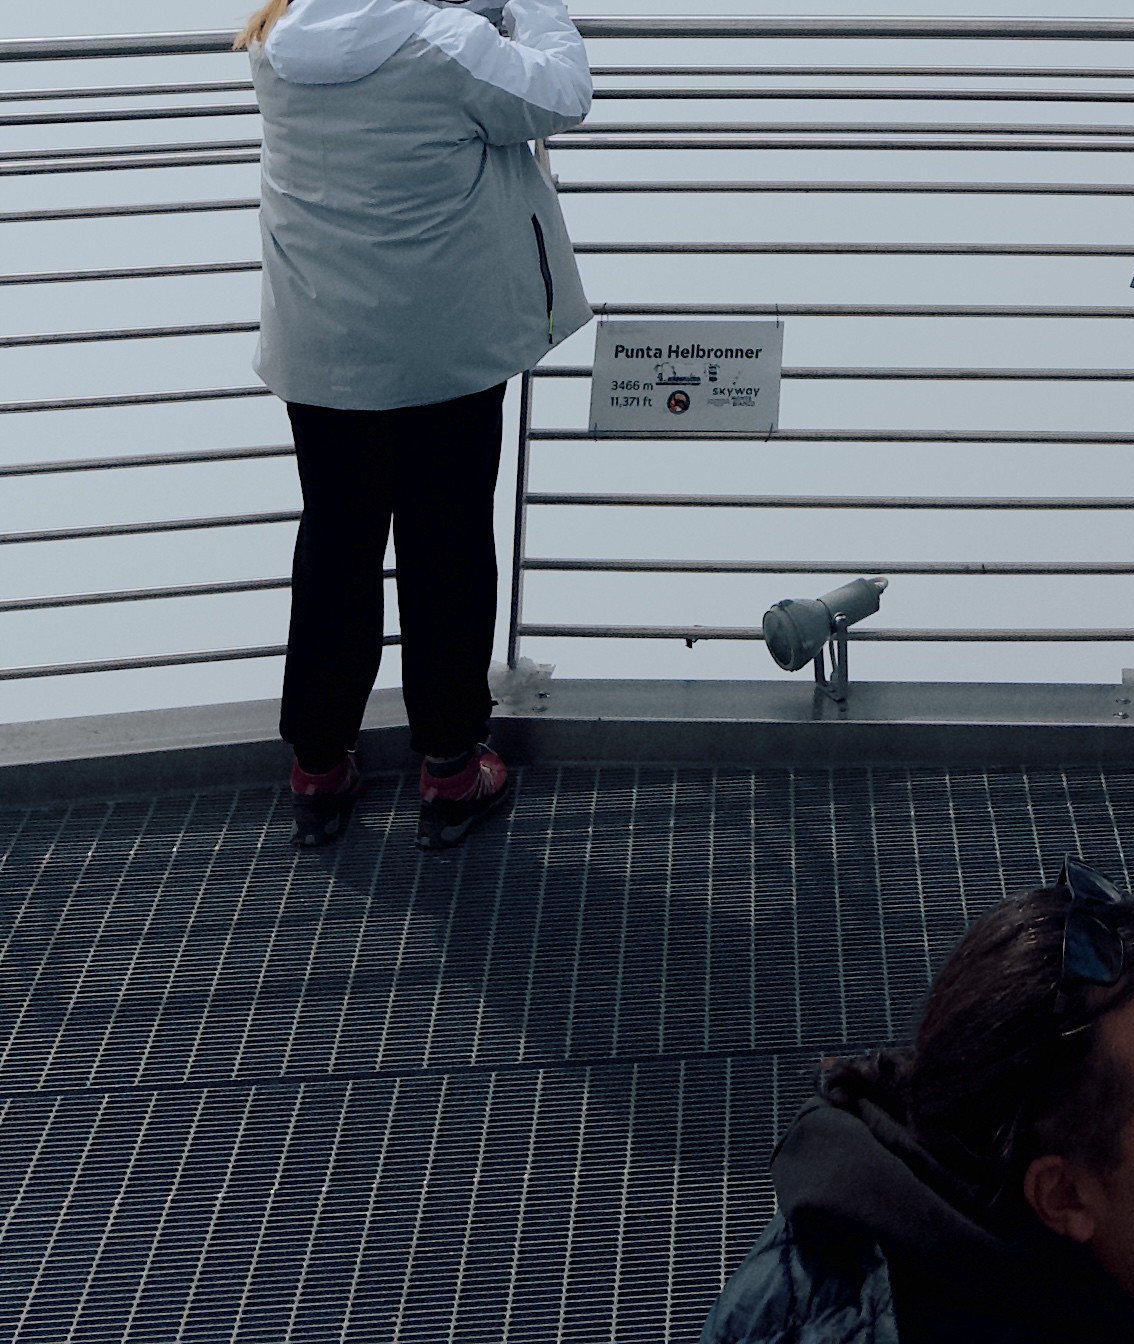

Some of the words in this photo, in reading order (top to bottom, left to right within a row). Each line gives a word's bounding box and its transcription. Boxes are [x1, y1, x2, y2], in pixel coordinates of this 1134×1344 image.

[614, 344, 662, 359] Punta
[667, 344, 762, 359] Helbronner
[611, 380, 640, 391] 3466
[643, 383, 653, 391] m
[712, 387, 760, 397] skyway
[610, 397, 640, 408] 11,371
[643, 396, 653, 407] ft
